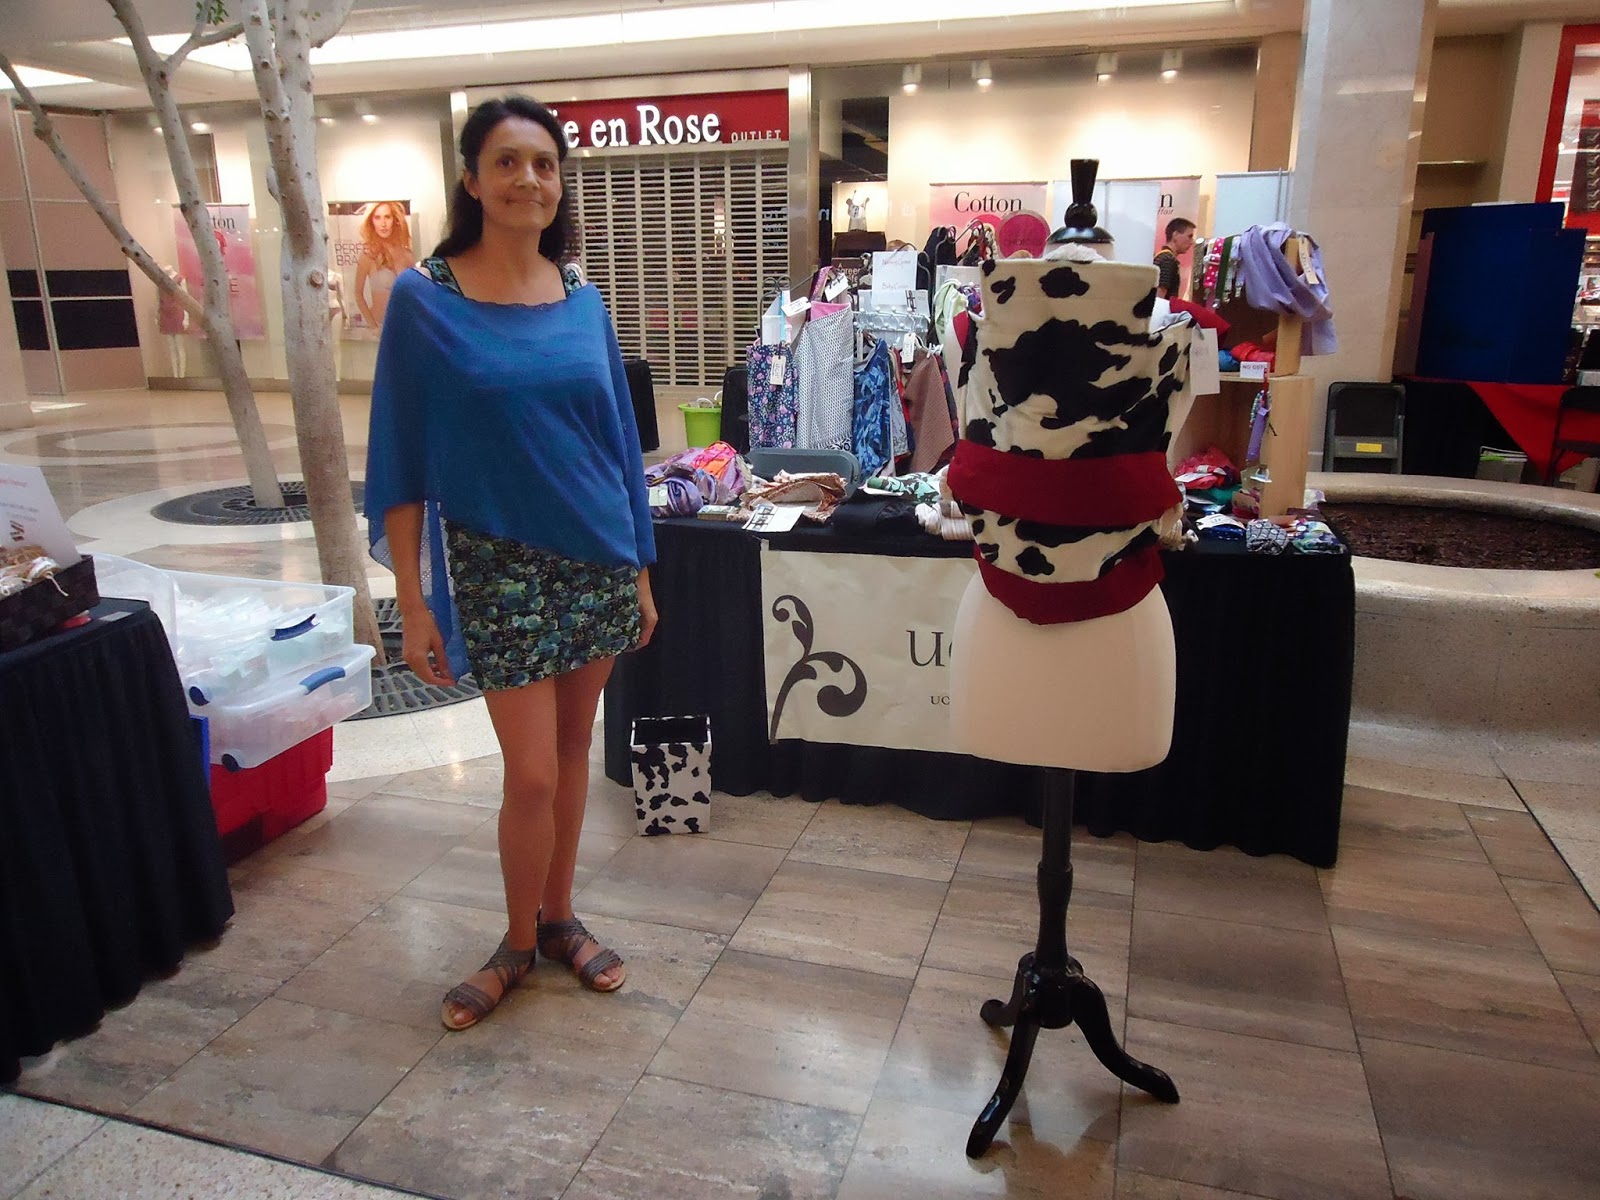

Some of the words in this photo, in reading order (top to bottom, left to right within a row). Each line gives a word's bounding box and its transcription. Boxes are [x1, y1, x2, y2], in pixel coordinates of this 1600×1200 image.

[590, 117, 629, 148] en
[636, 104, 721, 146] Rose
[731, 129, 782, 143] OUTLET
[954, 190, 1022, 213] Cotton
[212, 215, 235, 230] ton
[334, 243, 370, 255] PERFE
